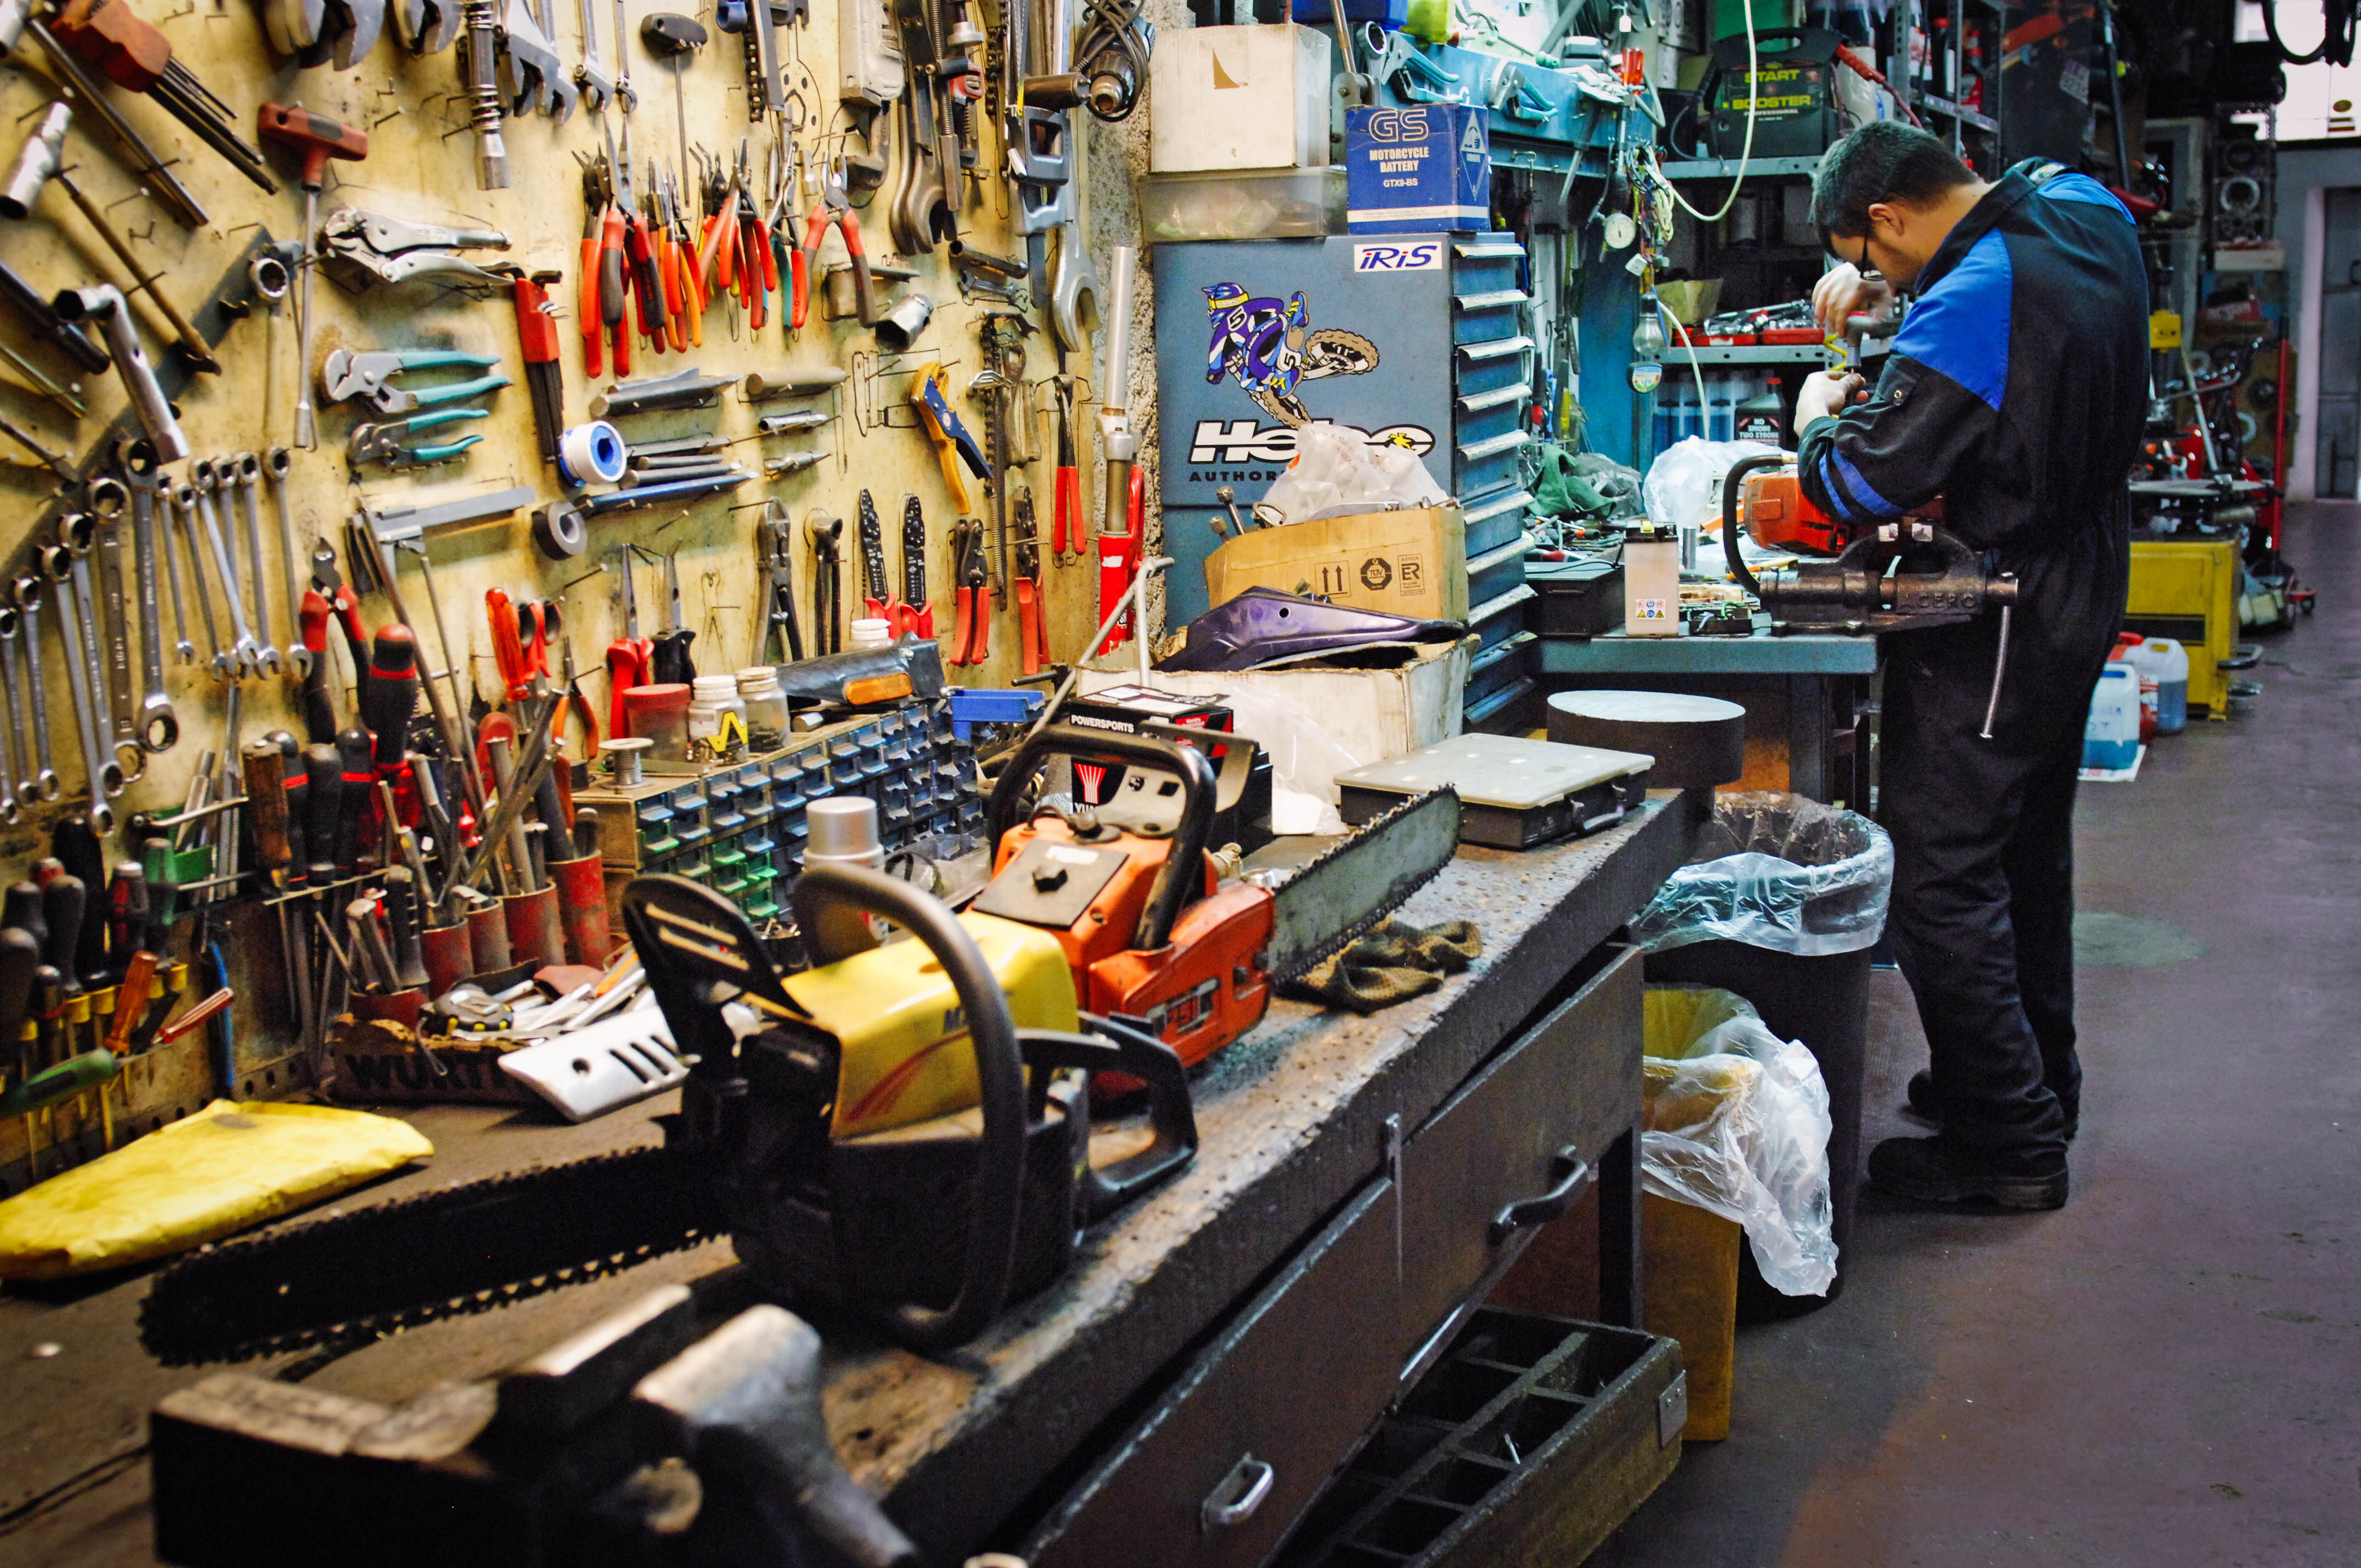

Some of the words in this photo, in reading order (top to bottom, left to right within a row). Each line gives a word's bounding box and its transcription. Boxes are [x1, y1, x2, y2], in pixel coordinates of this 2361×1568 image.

[1744, 69, 1800, 83] START
[1732, 94, 1811, 110] BOOSTER
[1368, 108, 1429, 143] GS
[1369, 146, 1429, 161] MOTORCYCLE
[1380, 160, 1419, 173] BATTERY
[1228, 308, 1246, 329] 5
[1189, 469, 1285, 482] AUTHOR
[1071, 715, 1134, 733] POWERSPORTS
